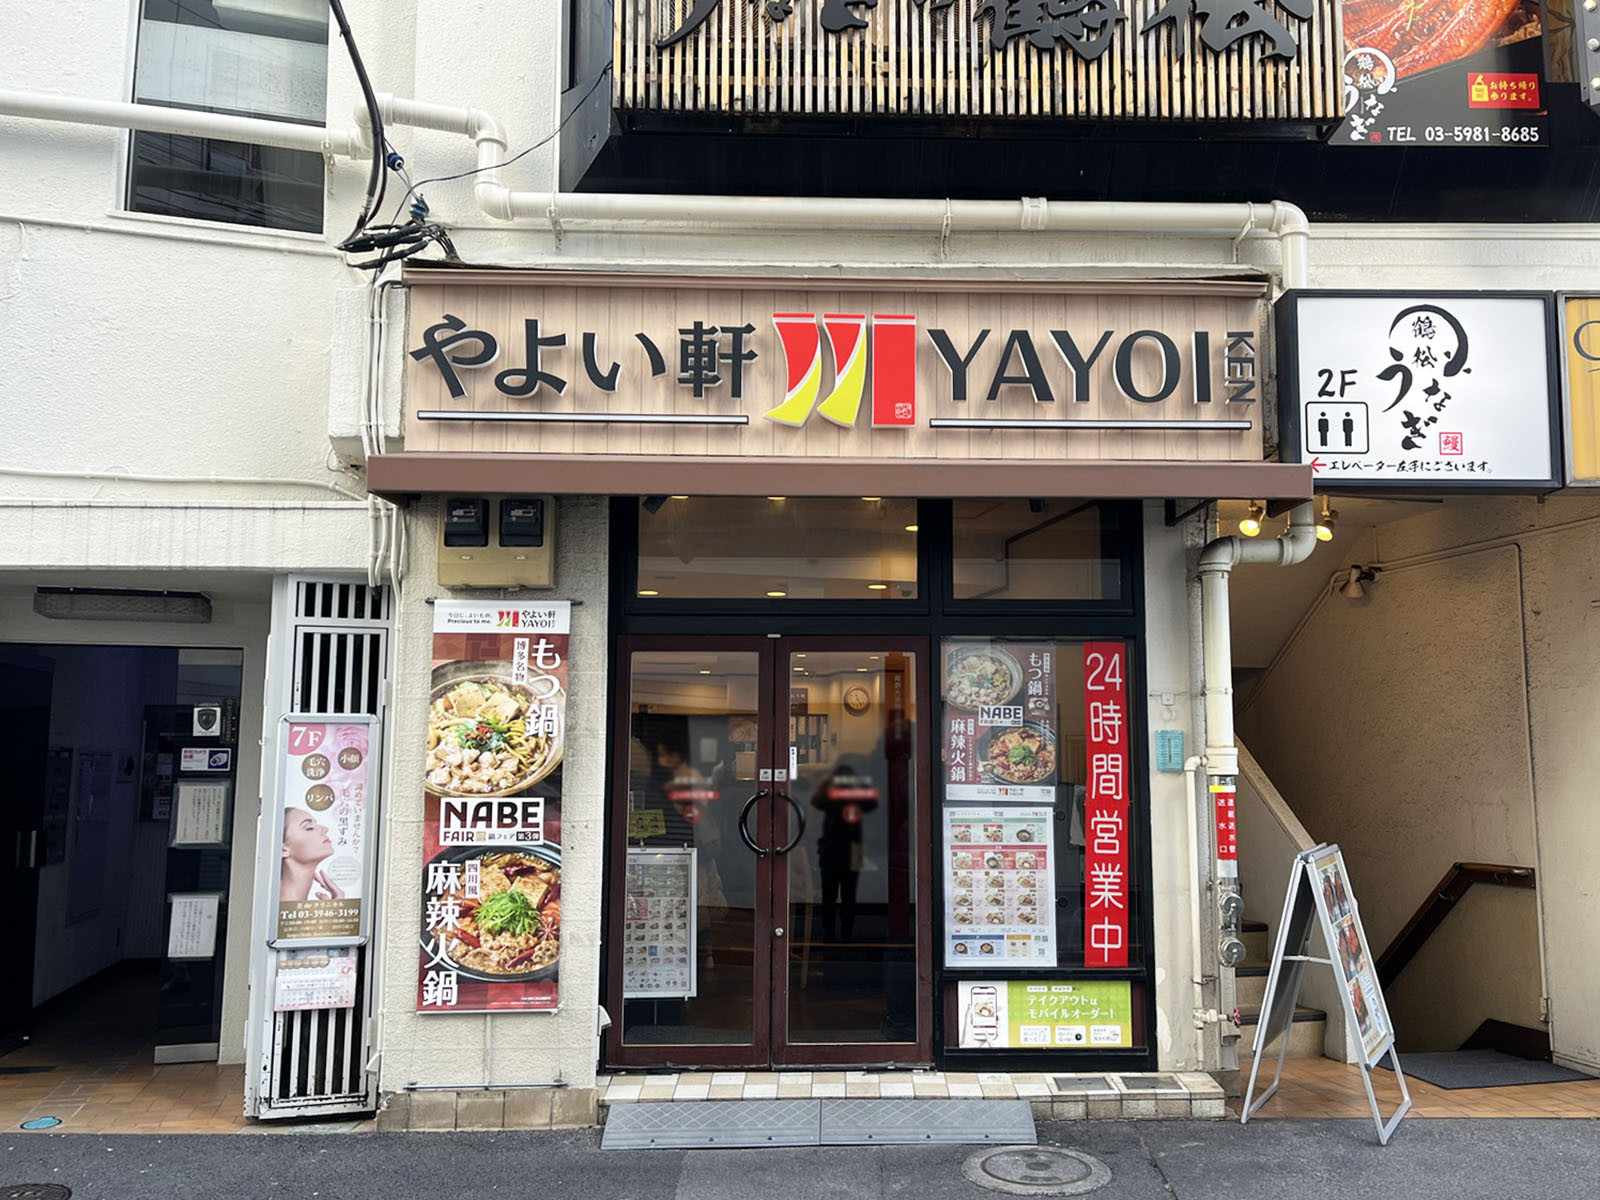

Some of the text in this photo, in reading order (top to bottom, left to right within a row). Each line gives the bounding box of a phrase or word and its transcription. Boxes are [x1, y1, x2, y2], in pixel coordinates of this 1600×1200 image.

[1387, 127, 1416, 142] TEL
[1425, 127, 1540, 142] 03-5981-8685
[409, 314, 759, 398] やよい軒
[1411, 316, 1438, 368] 鶴松
[926, 328, 1212, 404] YAYOI
[1224, 331, 1257, 404] KEN
[1318, 369, 1358, 398] 2F
[1376, 346, 1452, 450] うなぎ
[1329, 460, 1492, 474] エレベーター左手にございます。
[522, 610, 556, 618] やよい軒
[522, 619, 551, 628] YAYOI
[515, 640, 528, 684] 博多名物
[1028, 652, 1042, 696] もつ鍋
[525, 638, 561, 738] もつ鍋
[980, 707, 1022, 719] NABE
[292, 727, 322, 747] 7F
[951, 718, 966, 782] 麻辣火鍋
[307, 794, 333, 803] リンパ
[1086, 653, 1124, 963] 24時間営業中
[443, 801, 540, 829] NABE
[443, 831, 474, 842] FAIR
[467, 863, 478, 896] 四川風
[281, 908, 359, 919] Tel 03-3946-3199
[422, 860, 461, 1006] 麻辣火鍋
[1028, 995, 1097, 1006] テイクアウトは
